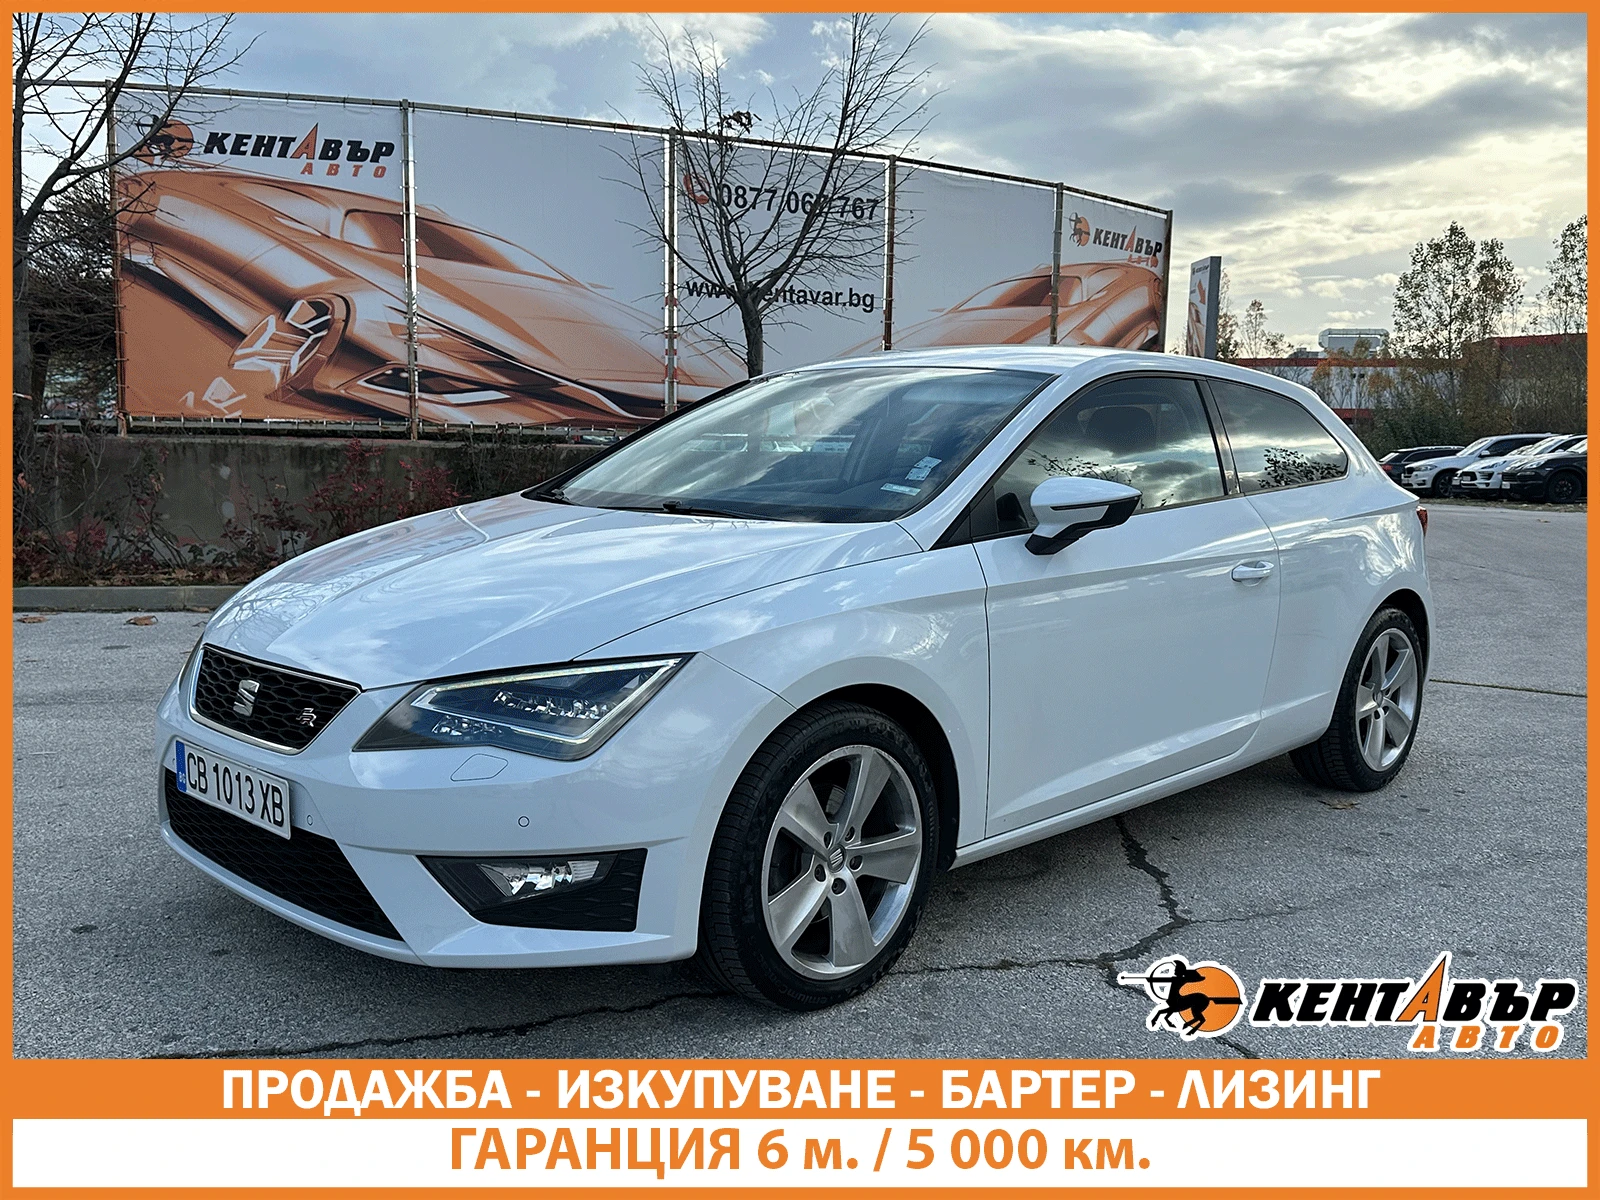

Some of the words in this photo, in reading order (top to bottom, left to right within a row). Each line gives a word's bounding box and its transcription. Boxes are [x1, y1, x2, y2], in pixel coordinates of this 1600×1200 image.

[203, 122, 395, 164] КЕНТАВЪР
[300, 162, 387, 179] АВТО
[720, 183, 778, 212] 0877
[1092, 225, 1163, 256] КЕНТАВЪР
[213, 762, 255, 815] 1013
